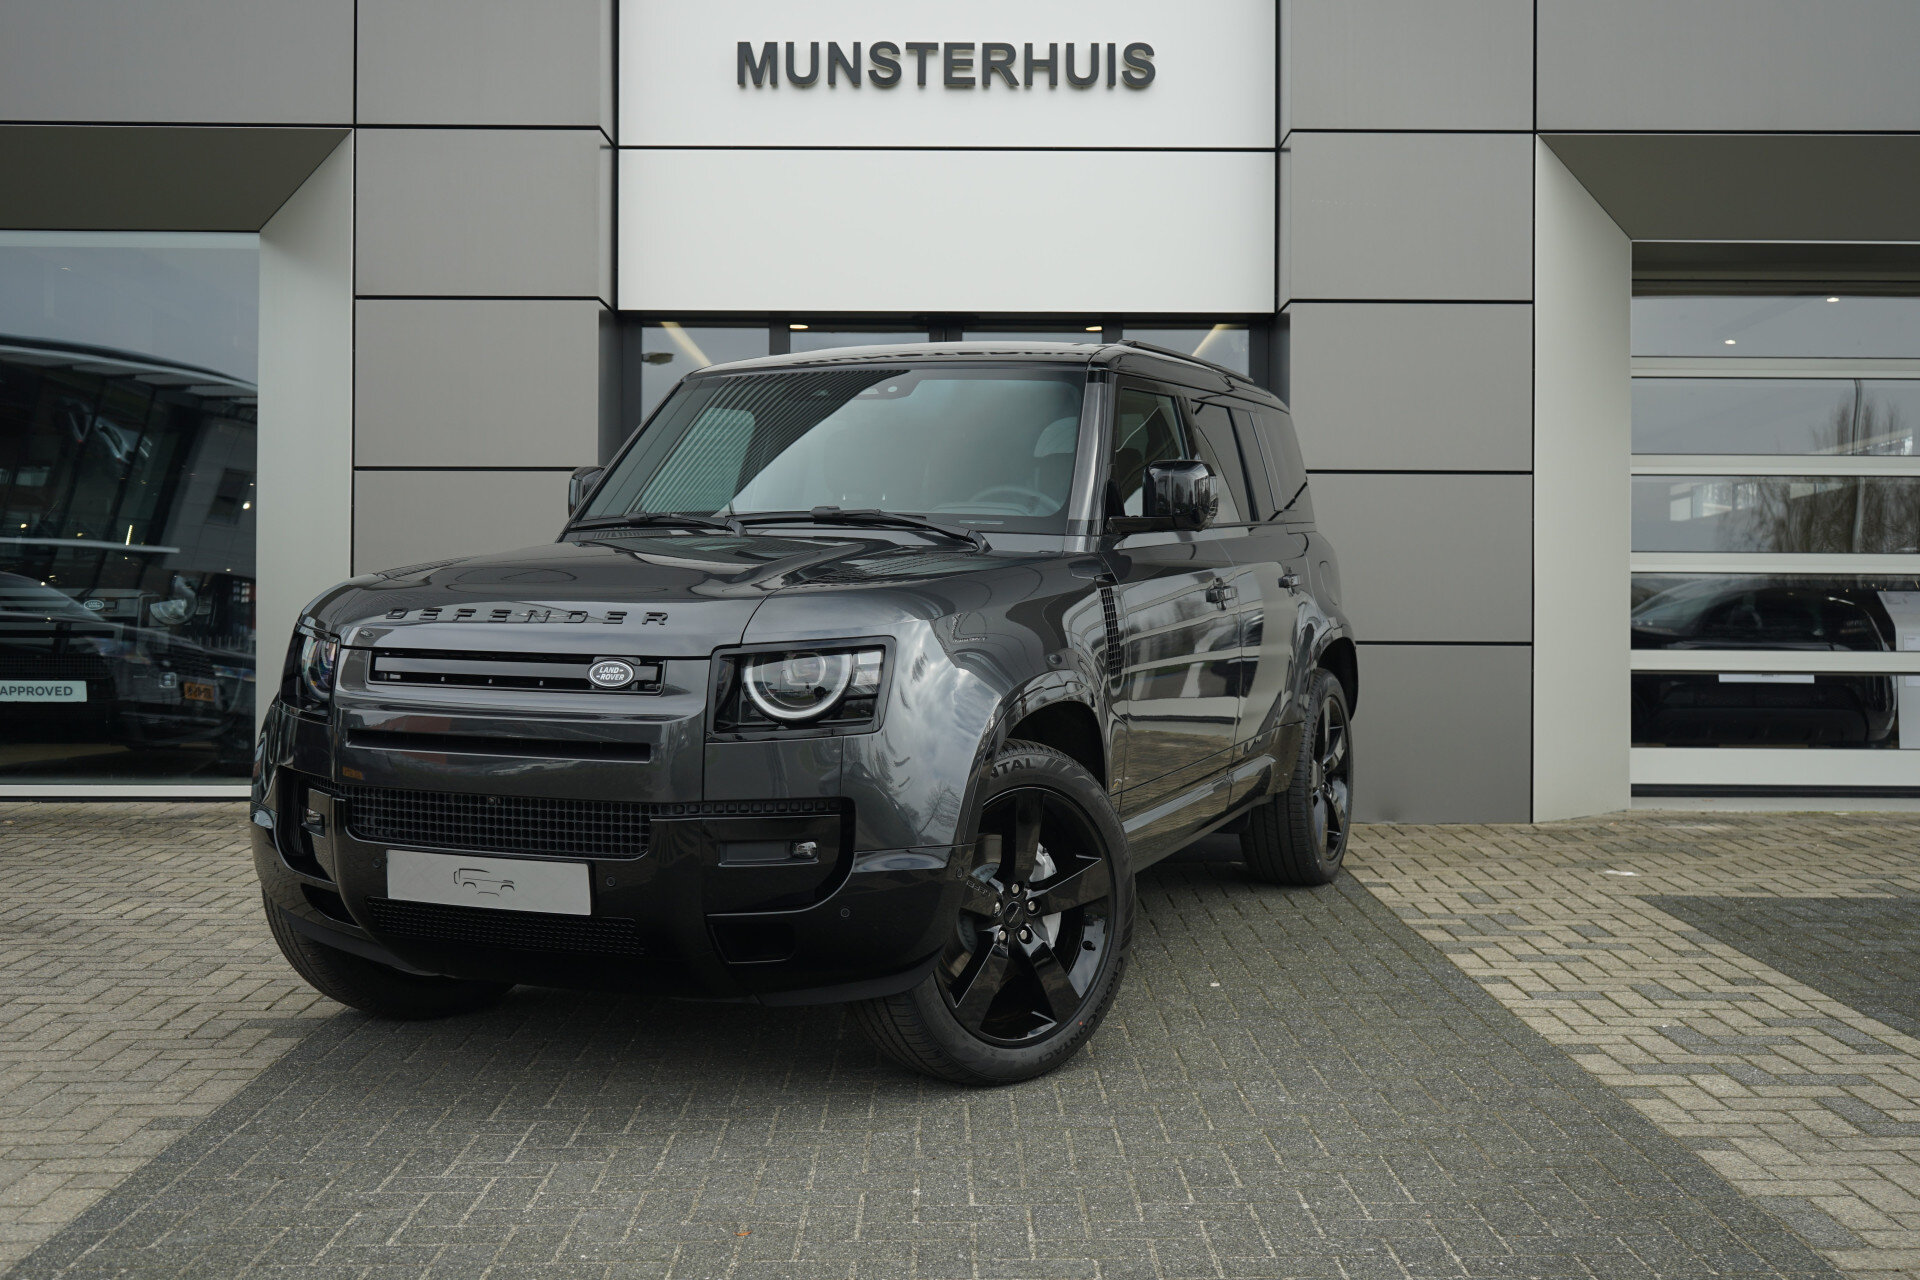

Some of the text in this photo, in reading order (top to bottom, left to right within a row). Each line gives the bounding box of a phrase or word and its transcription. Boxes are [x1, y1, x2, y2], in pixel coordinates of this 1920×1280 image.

[737, 41, 1157, 88] MUNSTERHUIS
[385, 607, 669, 626] DEFENDER
[0, 685, 73, 696] APPROVED
